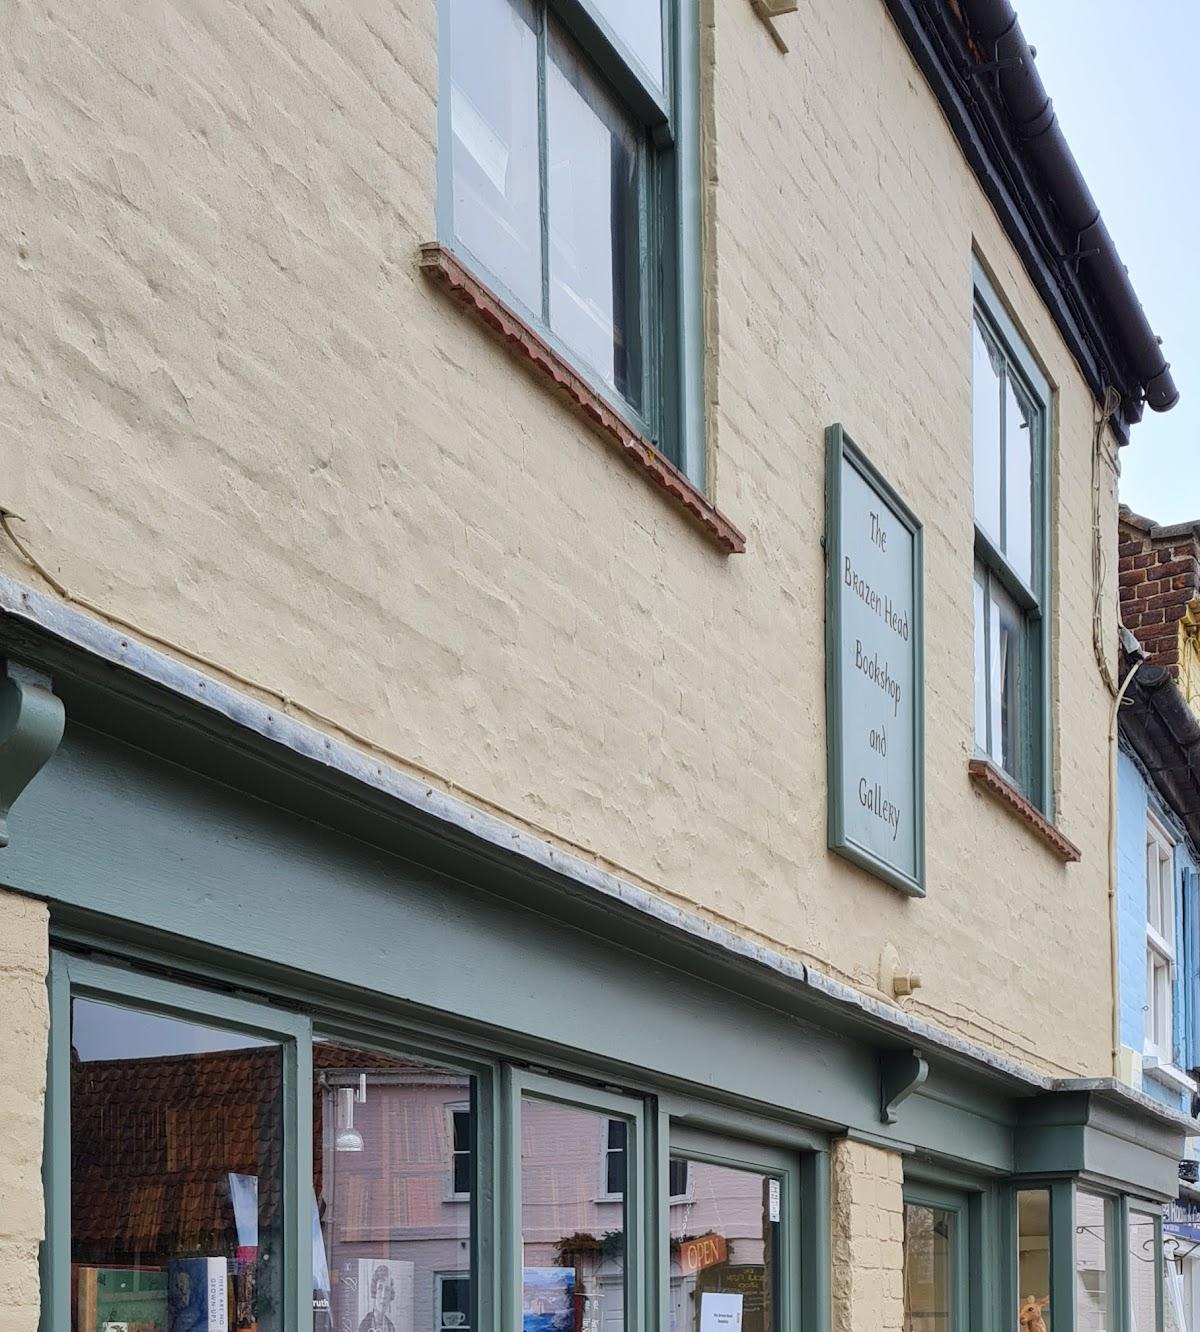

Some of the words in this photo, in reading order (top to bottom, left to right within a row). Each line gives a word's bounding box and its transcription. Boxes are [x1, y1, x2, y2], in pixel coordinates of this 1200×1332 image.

[869, 511, 887, 553] The
[844, 556, 881, 617] Brazen
[884, 595, 909, 642] Head
[855, 639, 901, 718] Bookshop
[869, 724, 887, 758] and
[858, 777, 900, 842] Gallery
[687, 1239, 720, 1270] OPEN
[312, 1298, 330, 1307] ruth
